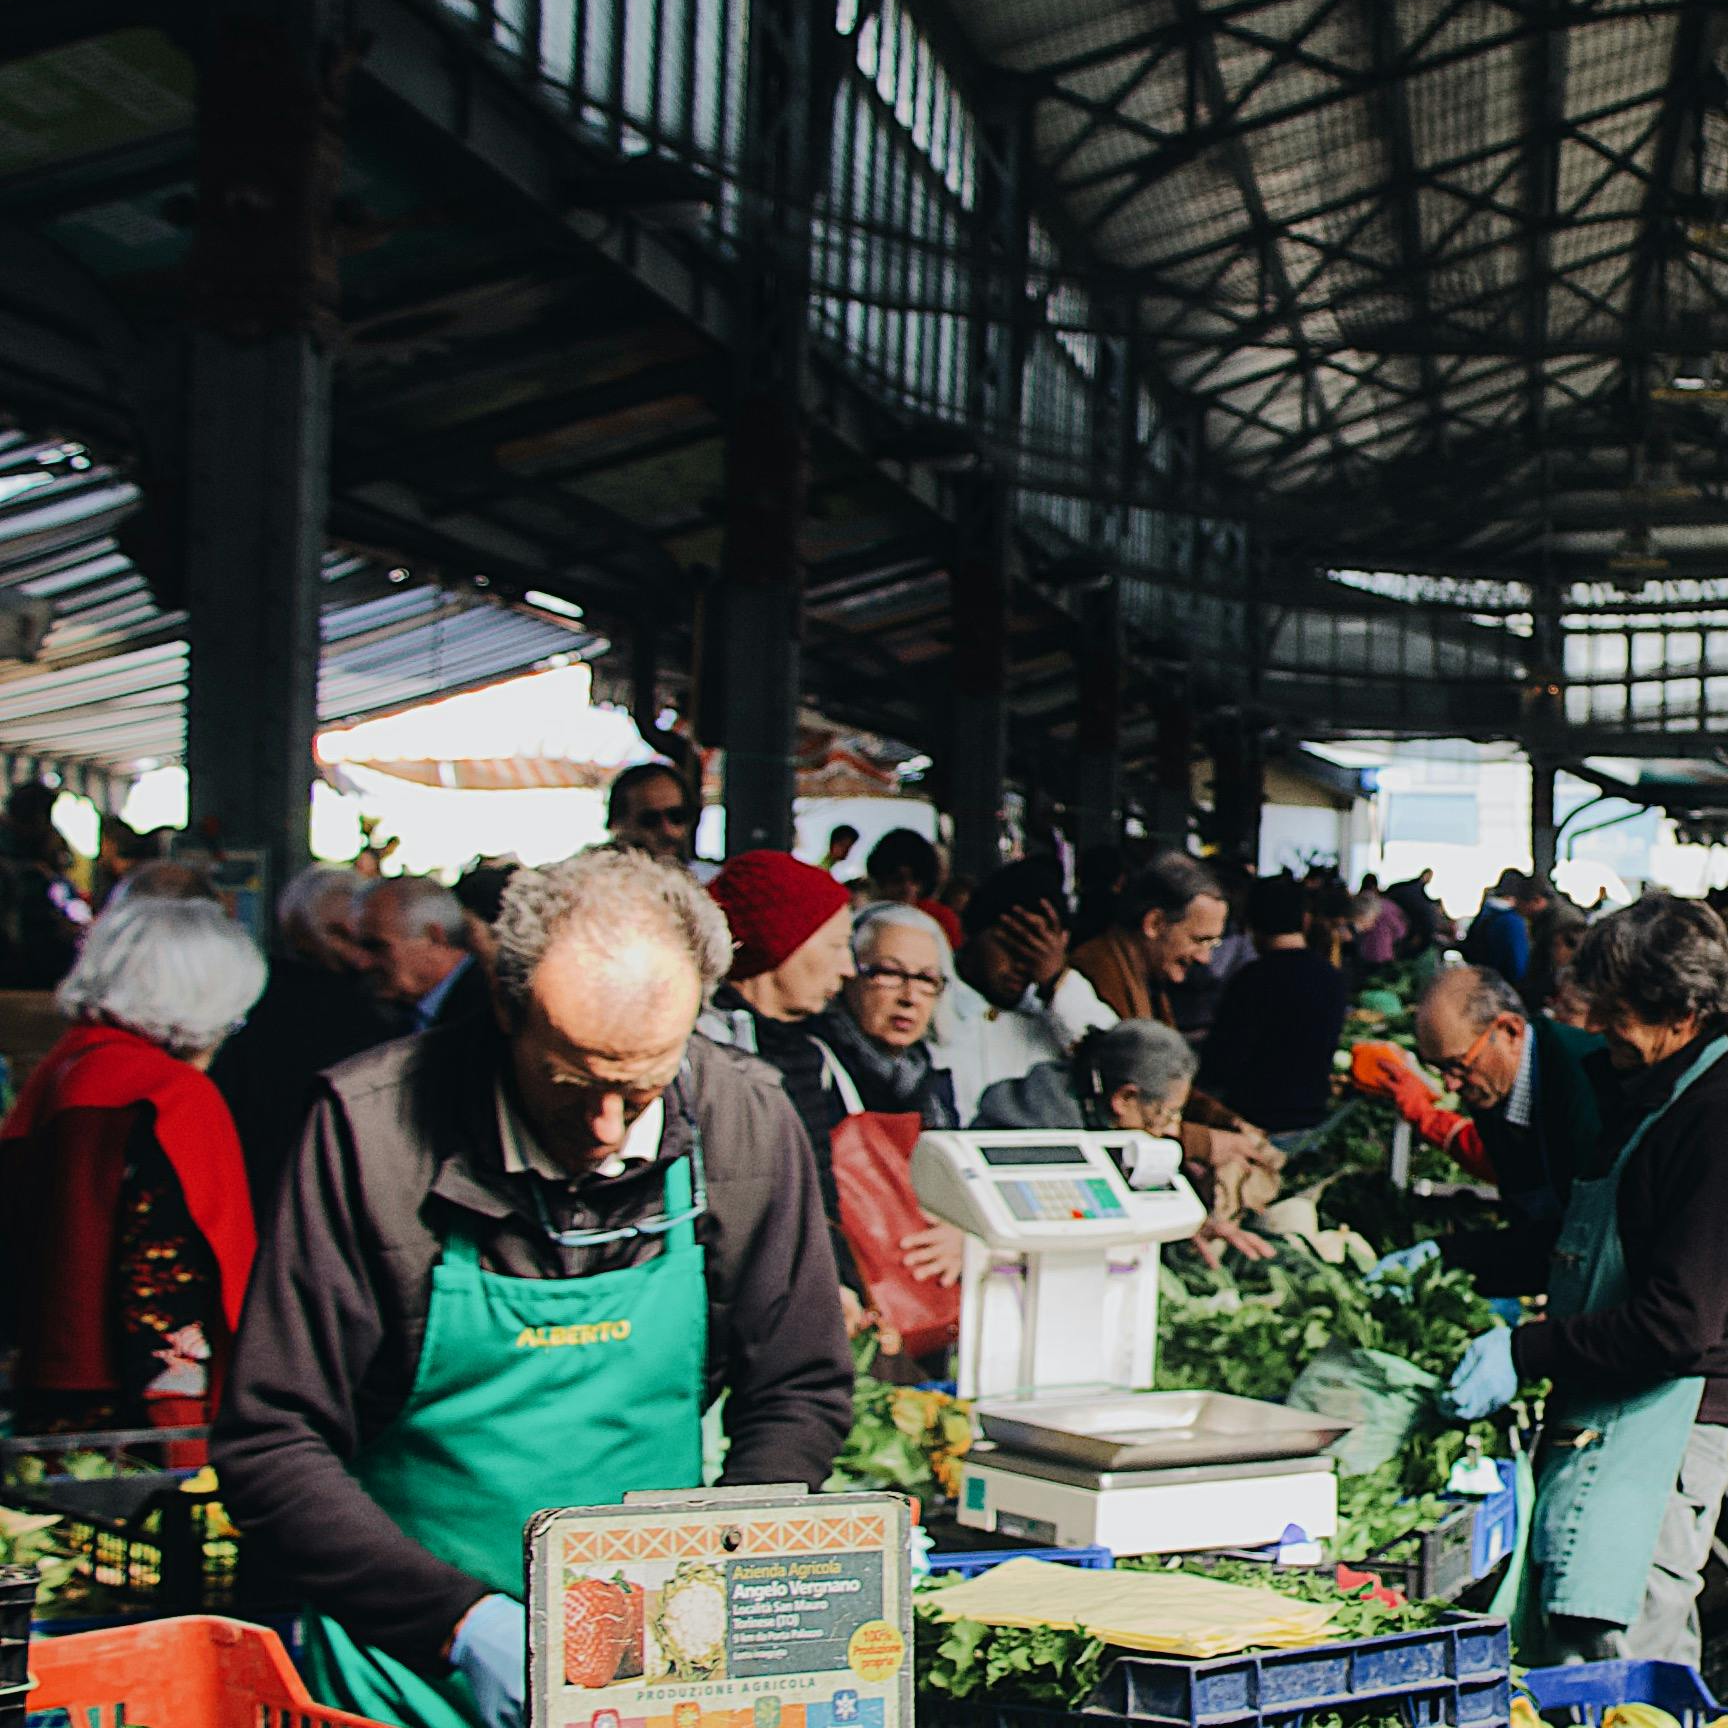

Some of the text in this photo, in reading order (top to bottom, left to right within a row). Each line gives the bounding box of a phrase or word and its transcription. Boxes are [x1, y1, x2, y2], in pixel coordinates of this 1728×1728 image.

[515, 1319, 632, 1349] ALBERTO
[732, 1559, 843, 1580] Azienda Agricola
[732, 1578, 862, 1602] Angelo Vergnano
[635, 1677, 817, 1702] PRODUZIONE AGRICOLA
